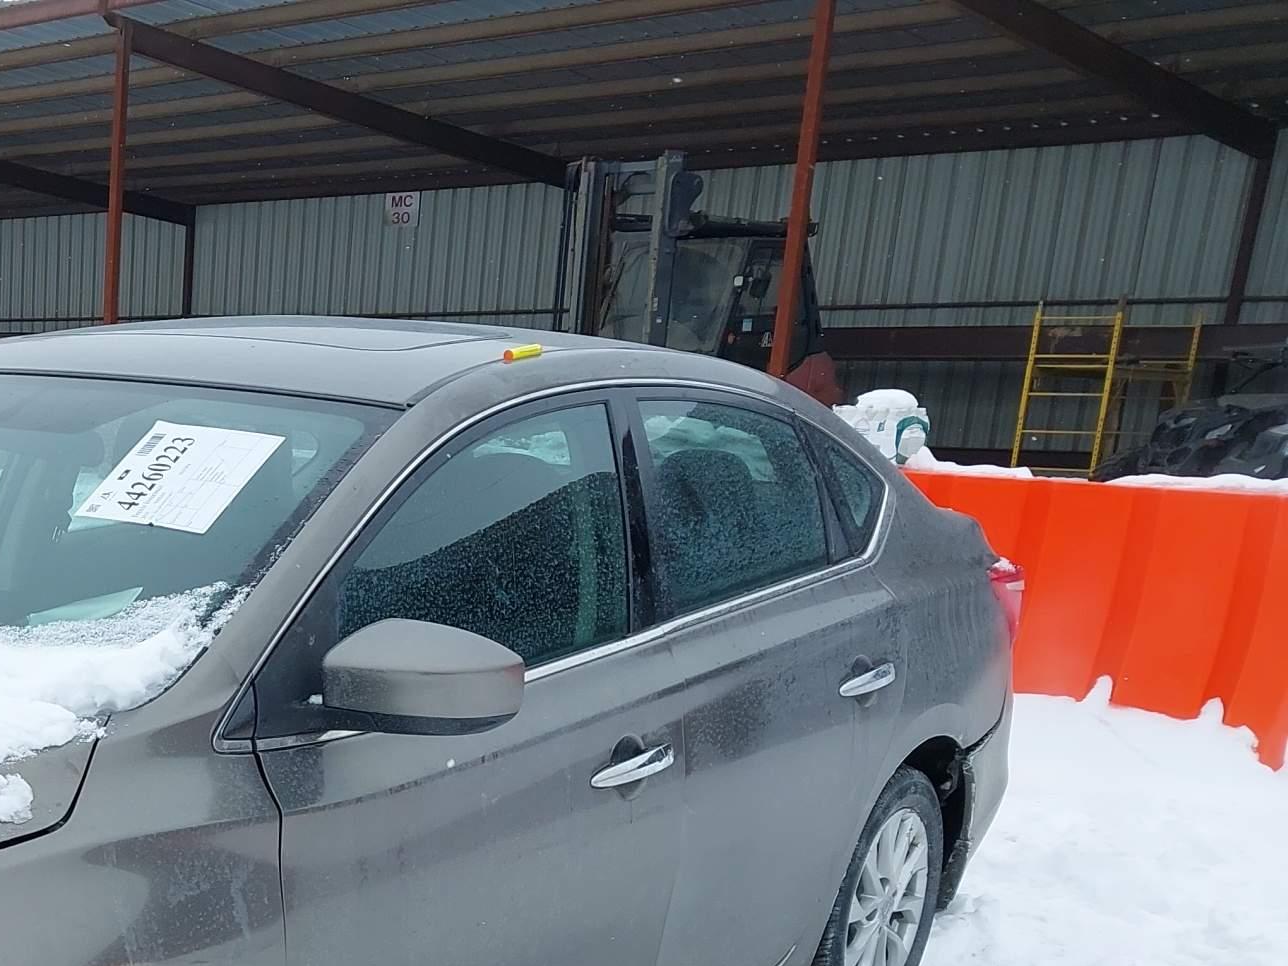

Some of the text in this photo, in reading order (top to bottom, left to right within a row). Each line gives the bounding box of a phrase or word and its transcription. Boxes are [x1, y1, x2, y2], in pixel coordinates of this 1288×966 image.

[392, 195, 413, 208] MC
[392, 212, 410, 224] 30
[117, 437, 196, 511] 44260223
